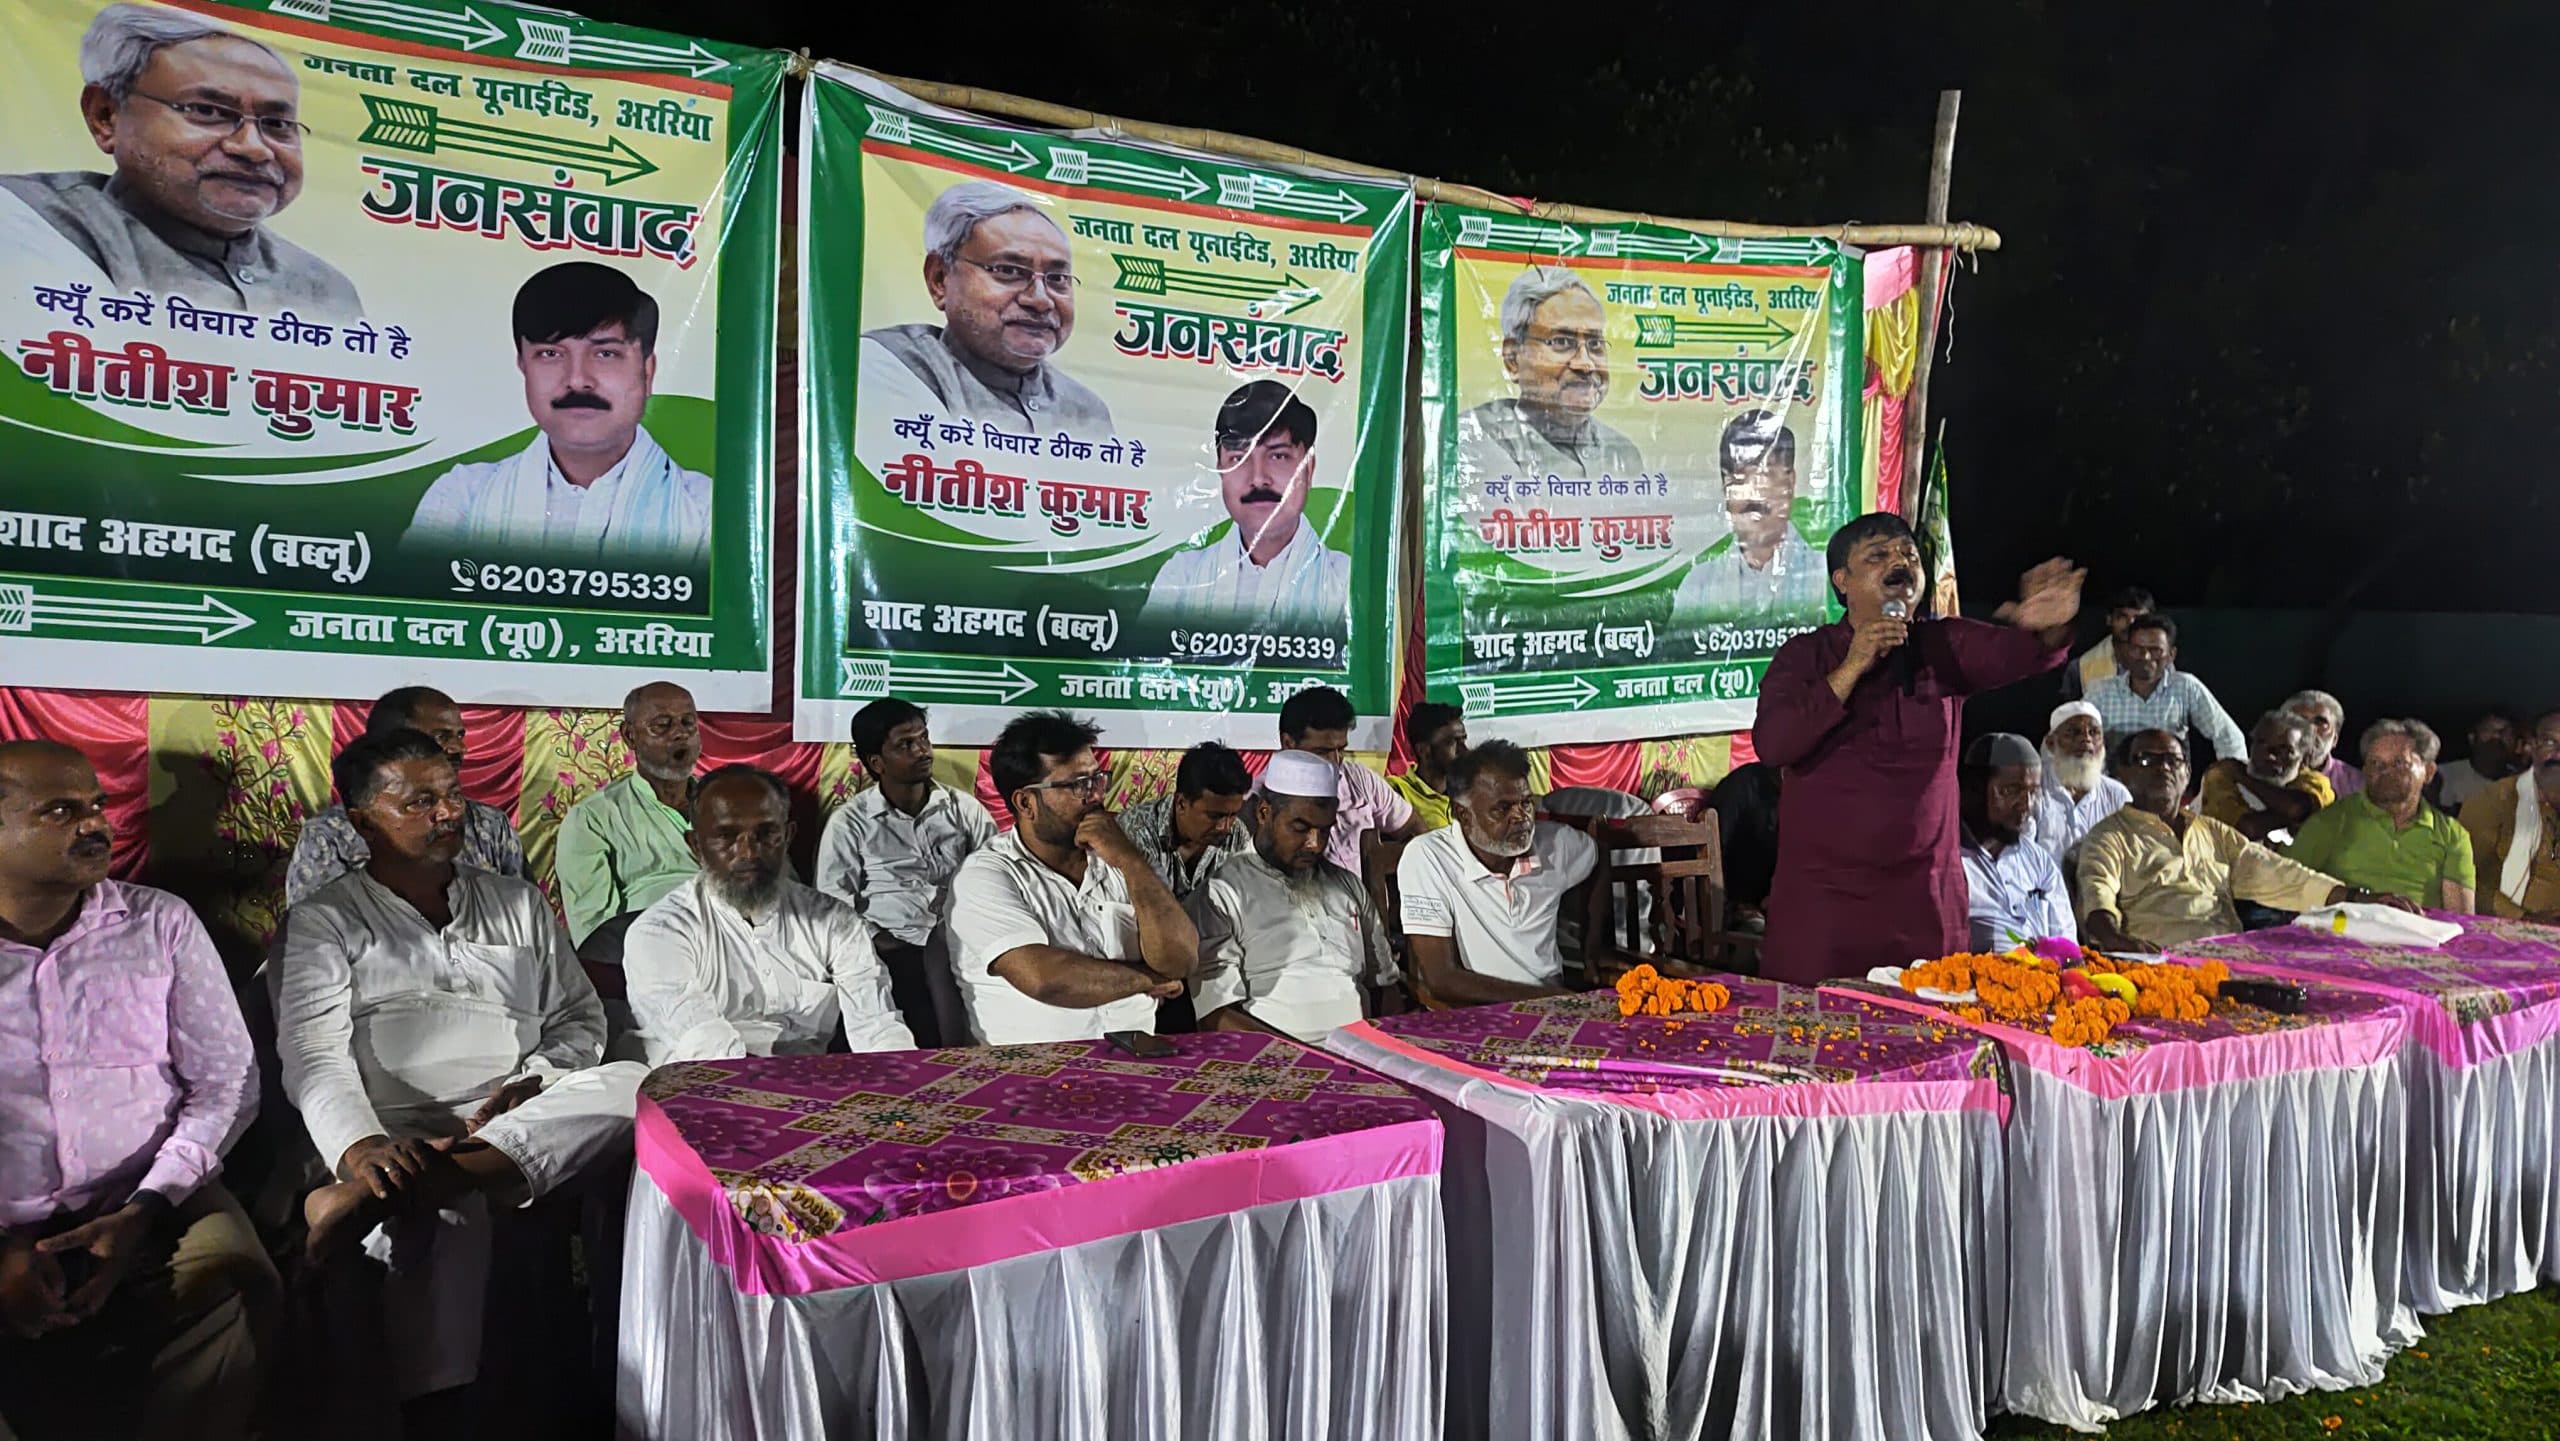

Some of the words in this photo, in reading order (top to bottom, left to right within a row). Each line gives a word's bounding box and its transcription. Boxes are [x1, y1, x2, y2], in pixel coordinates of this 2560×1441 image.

[407, 68, 461, 97] दल
[617, 98, 714, 141] अररिया
[361, 156, 704, 270] जनसंवाद
[1068, 215, 1134, 244] जनता
[1141, 224, 1180, 250] दल
[1288, 240, 1359, 273] अररिया
[34, 282, 95, 328] क्यूँ
[100, 290, 152, 326] करें
[167, 295, 258, 339] विचार
[269, 311, 333, 347] ठीक
[344, 321, 378, 354] तो
[384, 325, 411, 360] है
[1605, 282, 1653, 304] जनता
[1659, 285, 1686, 306] दल
[1767, 285, 1822, 310] अररिया
[1113, 300, 1348, 383] जनसंवाद
[17, 331, 238, 416] नीतीश
[249, 367, 422, 441] कुमार
[1637, 345, 1818, 406] जनसंवाद
[894, 413, 935, 450] क्यूँ
[939, 418, 975, 446] करें
[982, 423, 1041, 456] विचार
[1049, 432, 1093, 460] ठीक
[1099, 437, 1123, 464] तो
[1129, 440, 1147, 467] है
[881, 453, 1030, 520] नीतीश
[1037, 479, 1152, 536] कुमार
[1485, 474, 1513, 503] क्यूँ
[1515, 475, 1541, 497] करें
[1547, 475, 1592, 497] विचार
[1597, 474, 1629, 496] ठीक
[1634, 474, 1651, 496] तो
[1655, 472, 1668, 497] है
[99, 519, 236, 562] अहमद
[250, 523, 371, 584] (बब्लू)
[1479, 508, 1584, 553] नीतीश
[1589, 515, 1674, 562] कुमार
[480, 563, 692, 601] 6203795339
[285, 610, 398, 642] जनता
[404, 616, 468, 646] दल
[595, 622, 714, 658] अररिया
[862, 600, 925, 631] शाद
[933, 604, 1027, 637] अहमद
[1037, 604, 1119, 652] (बब्लू)
[1190, 631, 1336, 660] 6203795339
[1471, 632, 1517, 659] शाद
[1522, 629, 1588, 656] अहमद
[1594, 619, 1655, 659] (बब्लू)
[1709, 626, 1818, 651] 6203795
[1058, 674, 1133, 700] जनता
[1138, 675, 1180, 700] दल
[1613, 676, 1669, 699] जनता
[1672, 673, 1705, 694] दल
